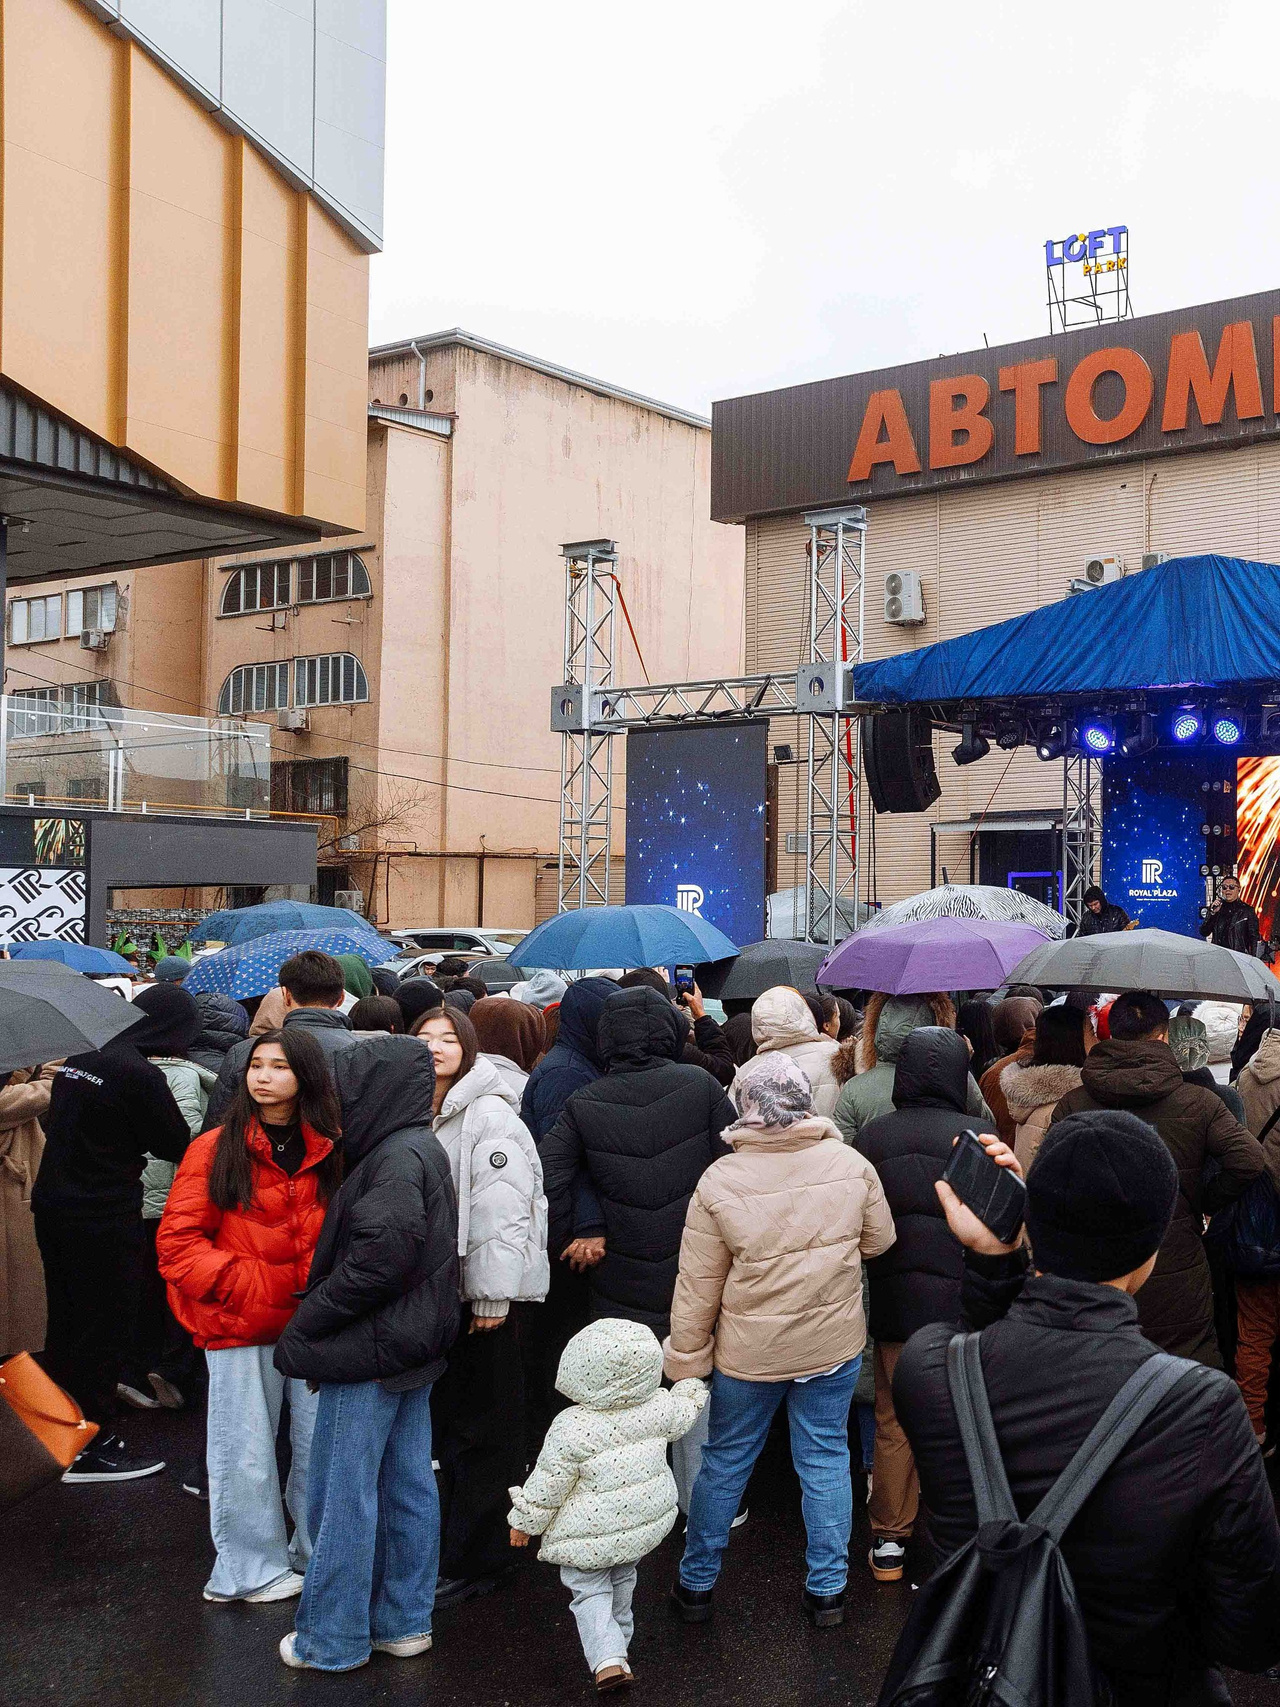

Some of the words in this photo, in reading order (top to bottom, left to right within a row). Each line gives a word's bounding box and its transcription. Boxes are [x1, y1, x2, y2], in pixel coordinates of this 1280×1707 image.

[1046, 225, 1128, 266] LOFT
[1083, 258, 1127, 276] PARK
[1128, 889, 1152, 897] ROYAL
[1153, 889, 1178, 897] PLAZA
